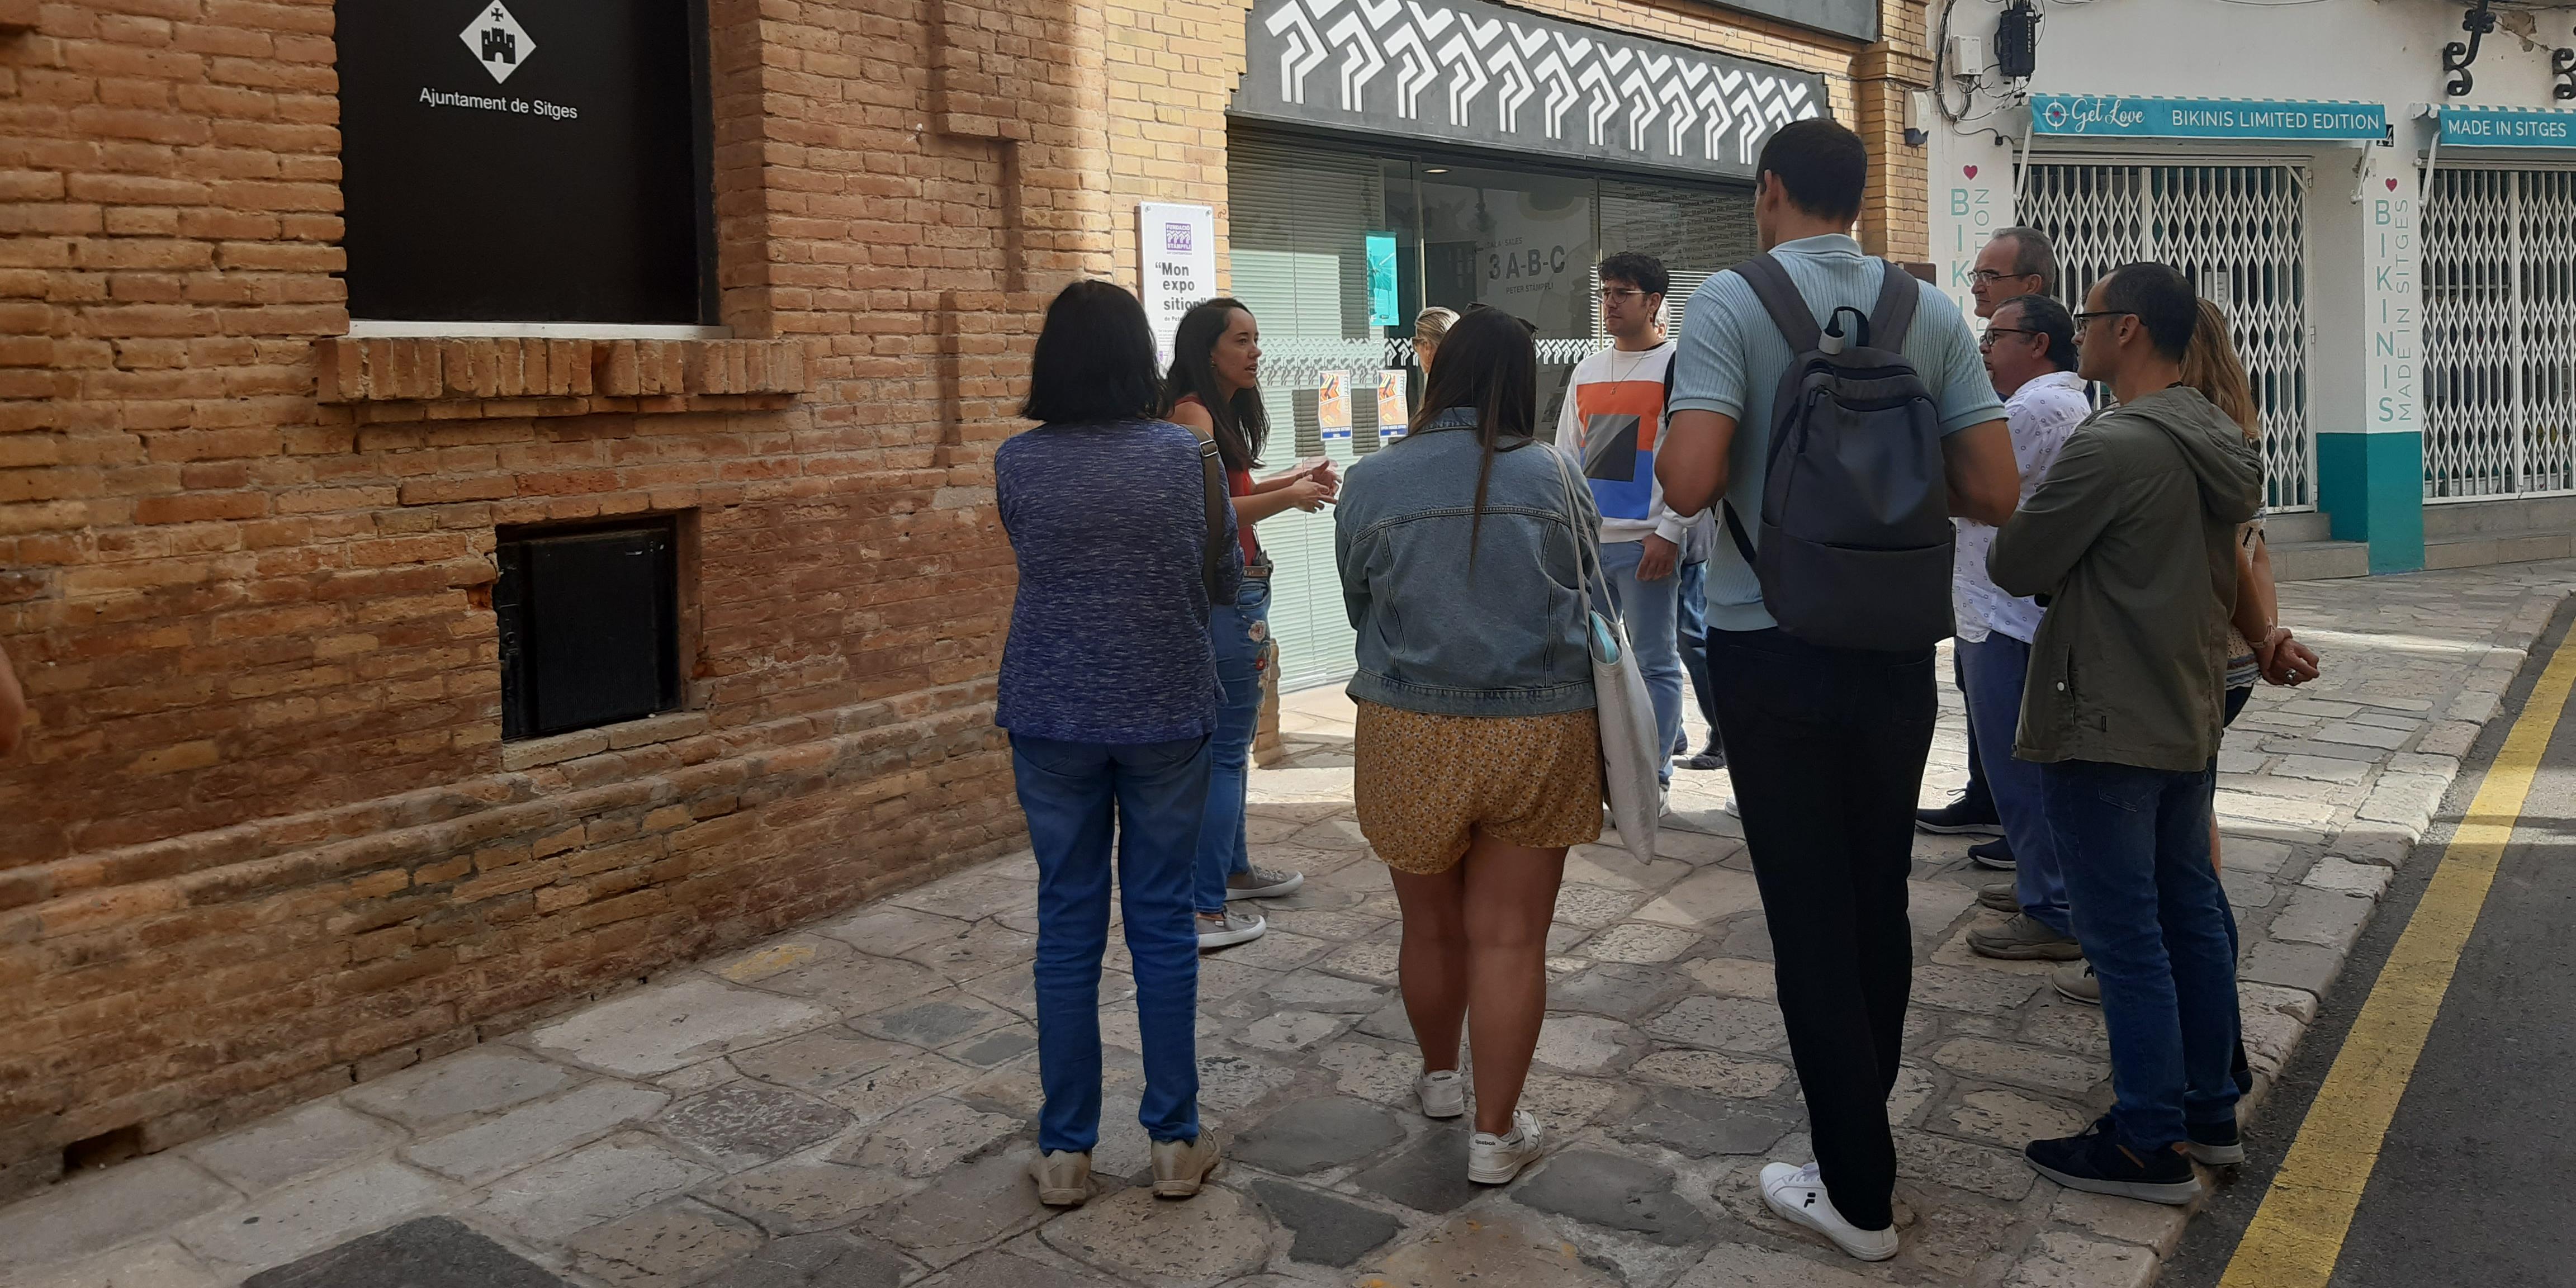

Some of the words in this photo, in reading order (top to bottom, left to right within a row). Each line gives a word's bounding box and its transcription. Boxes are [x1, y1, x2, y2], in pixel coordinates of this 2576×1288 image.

[420, 87, 506, 111] Ajuntament
[511, 98, 529, 113] de
[533, 100, 577, 120] Sitges
[2071, 98, 2106, 132] Get
[2105, 99, 2145, 127] Love
[2172, 109, 2234, 127] BIKINIS
[2239, 112, 2307, 128] LIMITED
[2313, 113, 2379, 130] EDITION
[2378, 126, 2393, 146] 4
[2448, 119, 2491, 135] MADE
[2496, 121, 2511, 135] IN
[2516, 121, 2567, 138] SITGES
[1974, 189, 1989, 254] TION
[1489, 254, 1501, 280] 3
[1506, 245, 1565, 279] A-B-C
[1951, 188, 1971, 314] BIKI
[2395, 200, 2409, 294] SITGES
[1155, 262, 1190, 276] “Mon
[1163, 280, 1195, 293] expo
[1506, 285, 1524, 294] PETER
[2375, 199, 2394, 422] BIKINIS
[2397, 309, 2410, 333] IN
[2397, 347, 2412, 420] MADE
